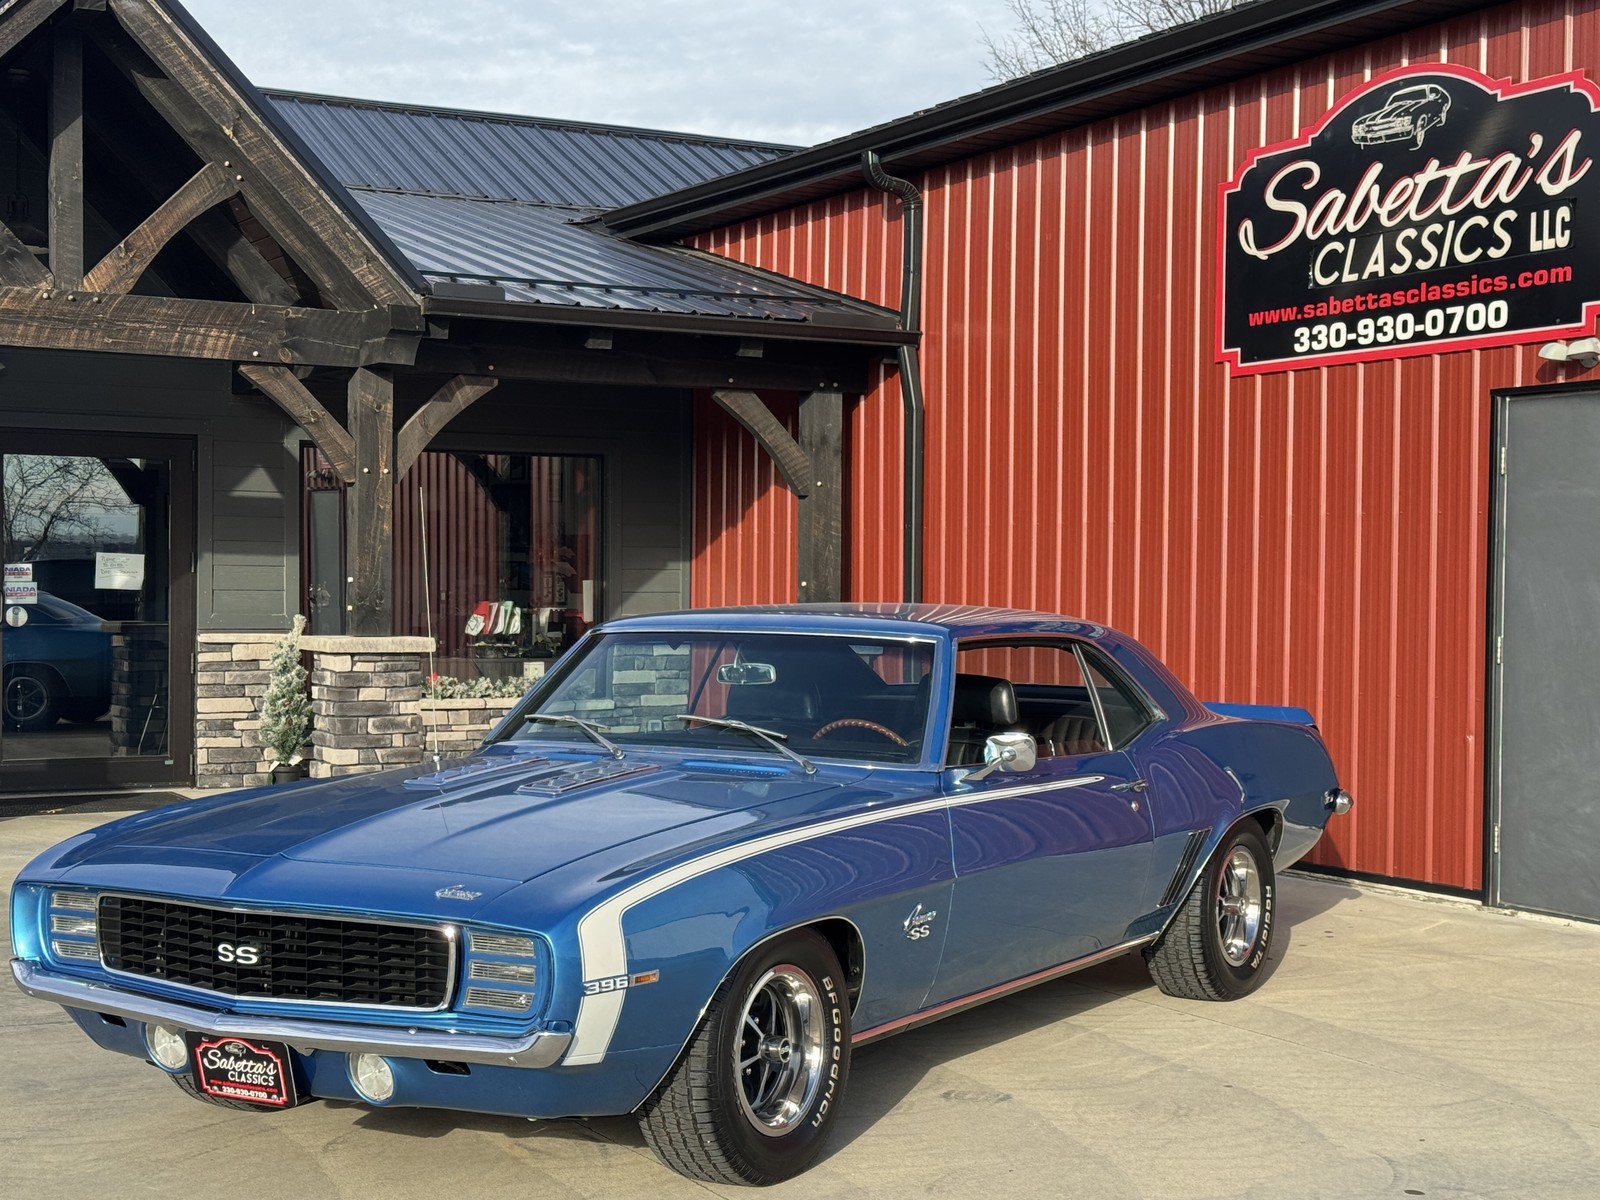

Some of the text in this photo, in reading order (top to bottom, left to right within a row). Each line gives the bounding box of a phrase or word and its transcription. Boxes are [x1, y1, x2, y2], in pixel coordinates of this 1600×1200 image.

[1238, 128, 1592, 260] Sabetta's
[1313, 206, 1571, 286] CLASSICS LLC
[1248, 264, 1573, 327] www.sabettasclassics.com
[1293, 300, 1509, 353] 330-930-0700
[907, 925, 930, 940] SS
[217, 943, 258, 965] SS
[584, 976, 629, 996] 396
[203, 1049, 277, 1075] Sabetta's
[228, 1070, 275, 1087] CLASSICS
